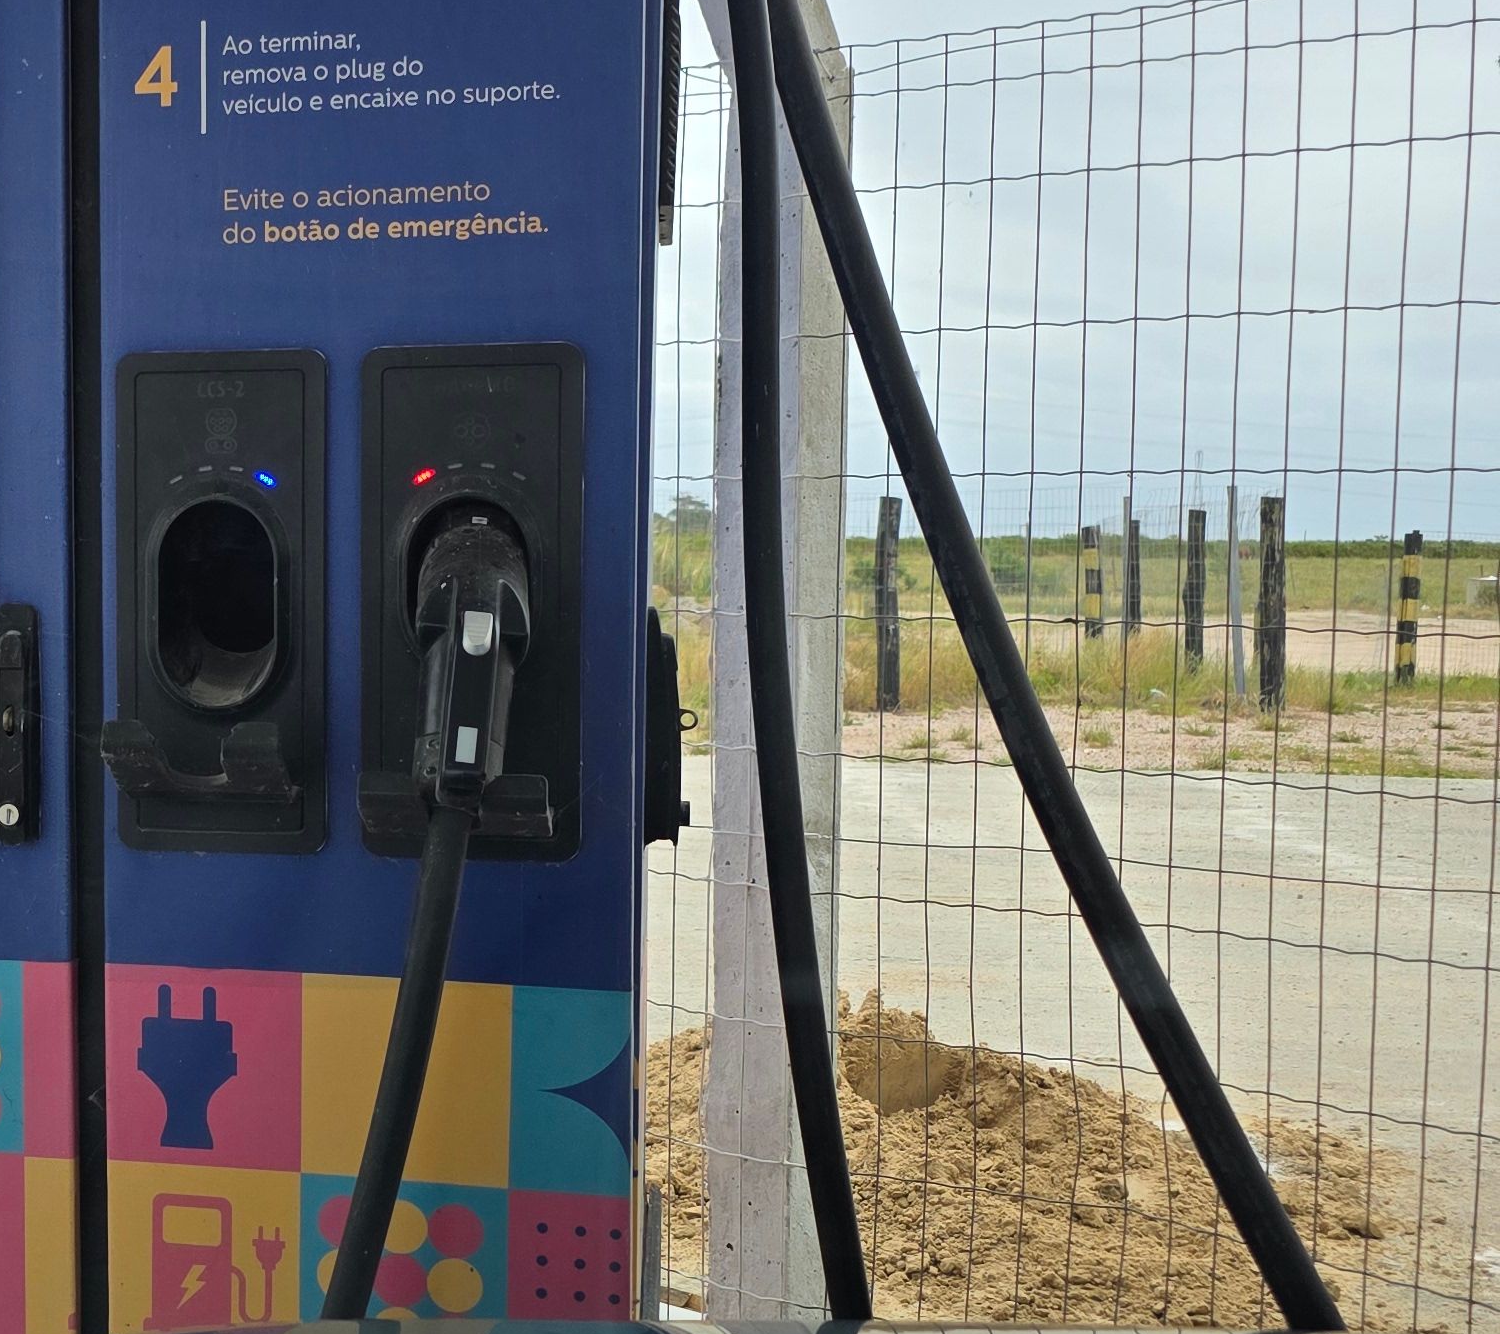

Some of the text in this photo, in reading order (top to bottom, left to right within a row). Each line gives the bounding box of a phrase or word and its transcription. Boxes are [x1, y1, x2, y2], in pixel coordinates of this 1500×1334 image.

[222, 29, 361, 56] Ao terminar,
[134, 45, 178, 107] 4
[222, 56, 424, 86] remova o plug do
[222, 81, 562, 116] veículo e encaixe no suporte.
[223, 181, 491, 211] Evite o acionamento
[222, 211, 550, 245] do botão de emergência.
